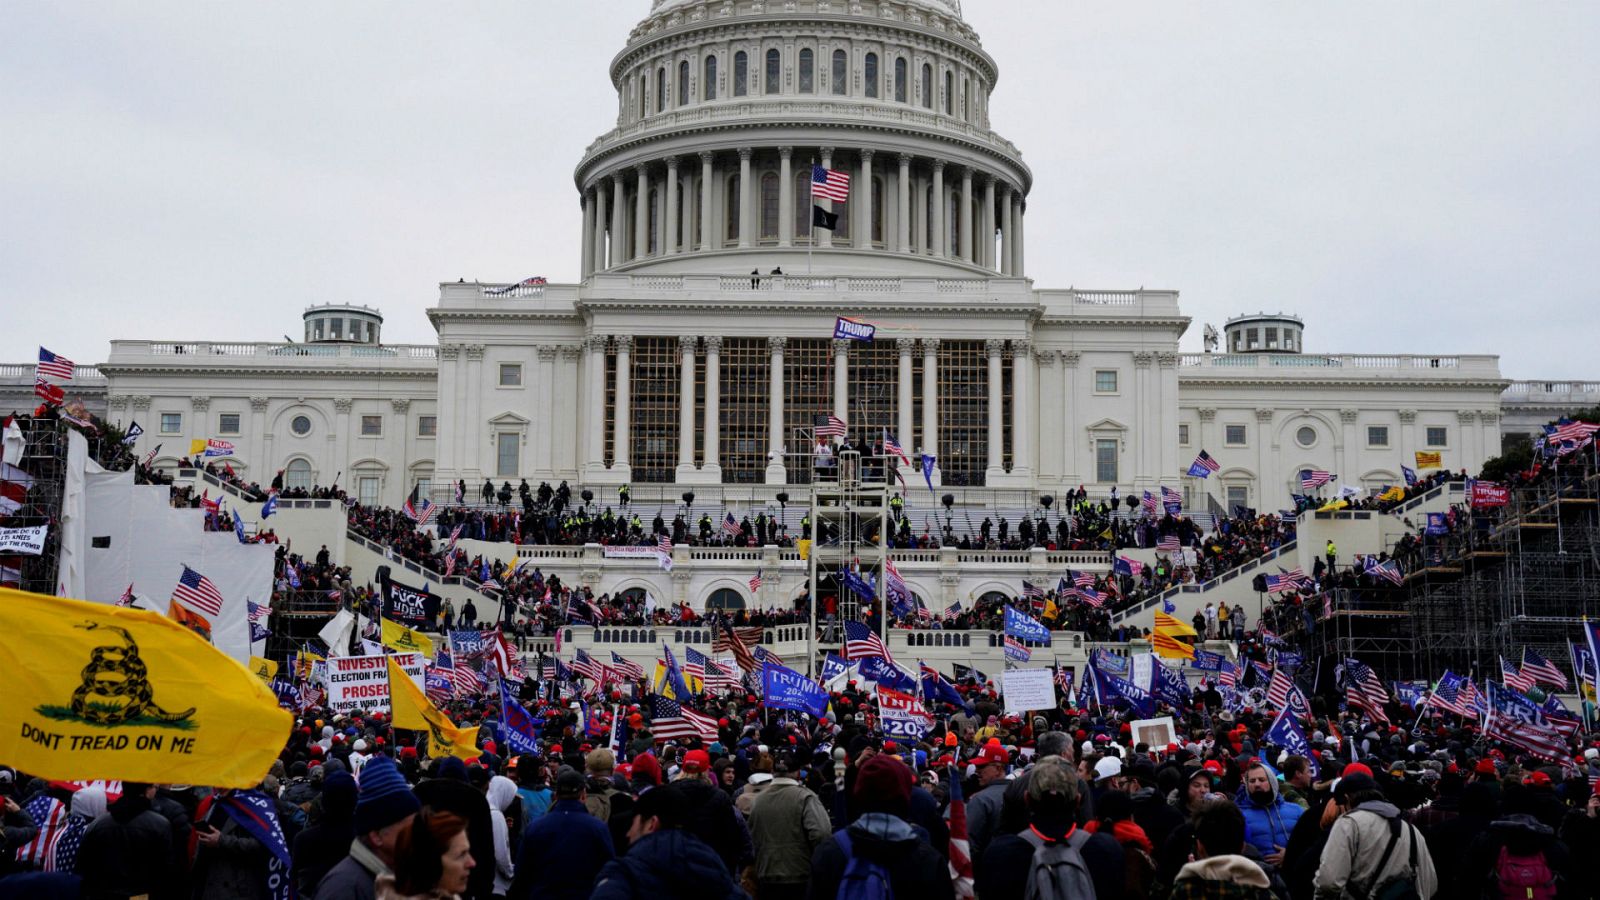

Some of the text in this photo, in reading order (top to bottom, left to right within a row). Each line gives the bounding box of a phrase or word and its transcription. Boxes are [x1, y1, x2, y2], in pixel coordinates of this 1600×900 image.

[840, 319, 873, 337] TRUMP
[1476, 488, 1506, 496] TRUMP
[21, 541, 41, 550] POWER
[391, 586, 427, 609] FUCK
[337, 654, 415, 671] INVESTIATE
[331, 671, 371, 682] ELECTION
[342, 684, 390, 699] PROSEC
[332, 698, 391, 710] THOSE WHO AR
[21, 722, 196, 754] DONT TREAD ON ME
[890, 721, 923, 739] 202
